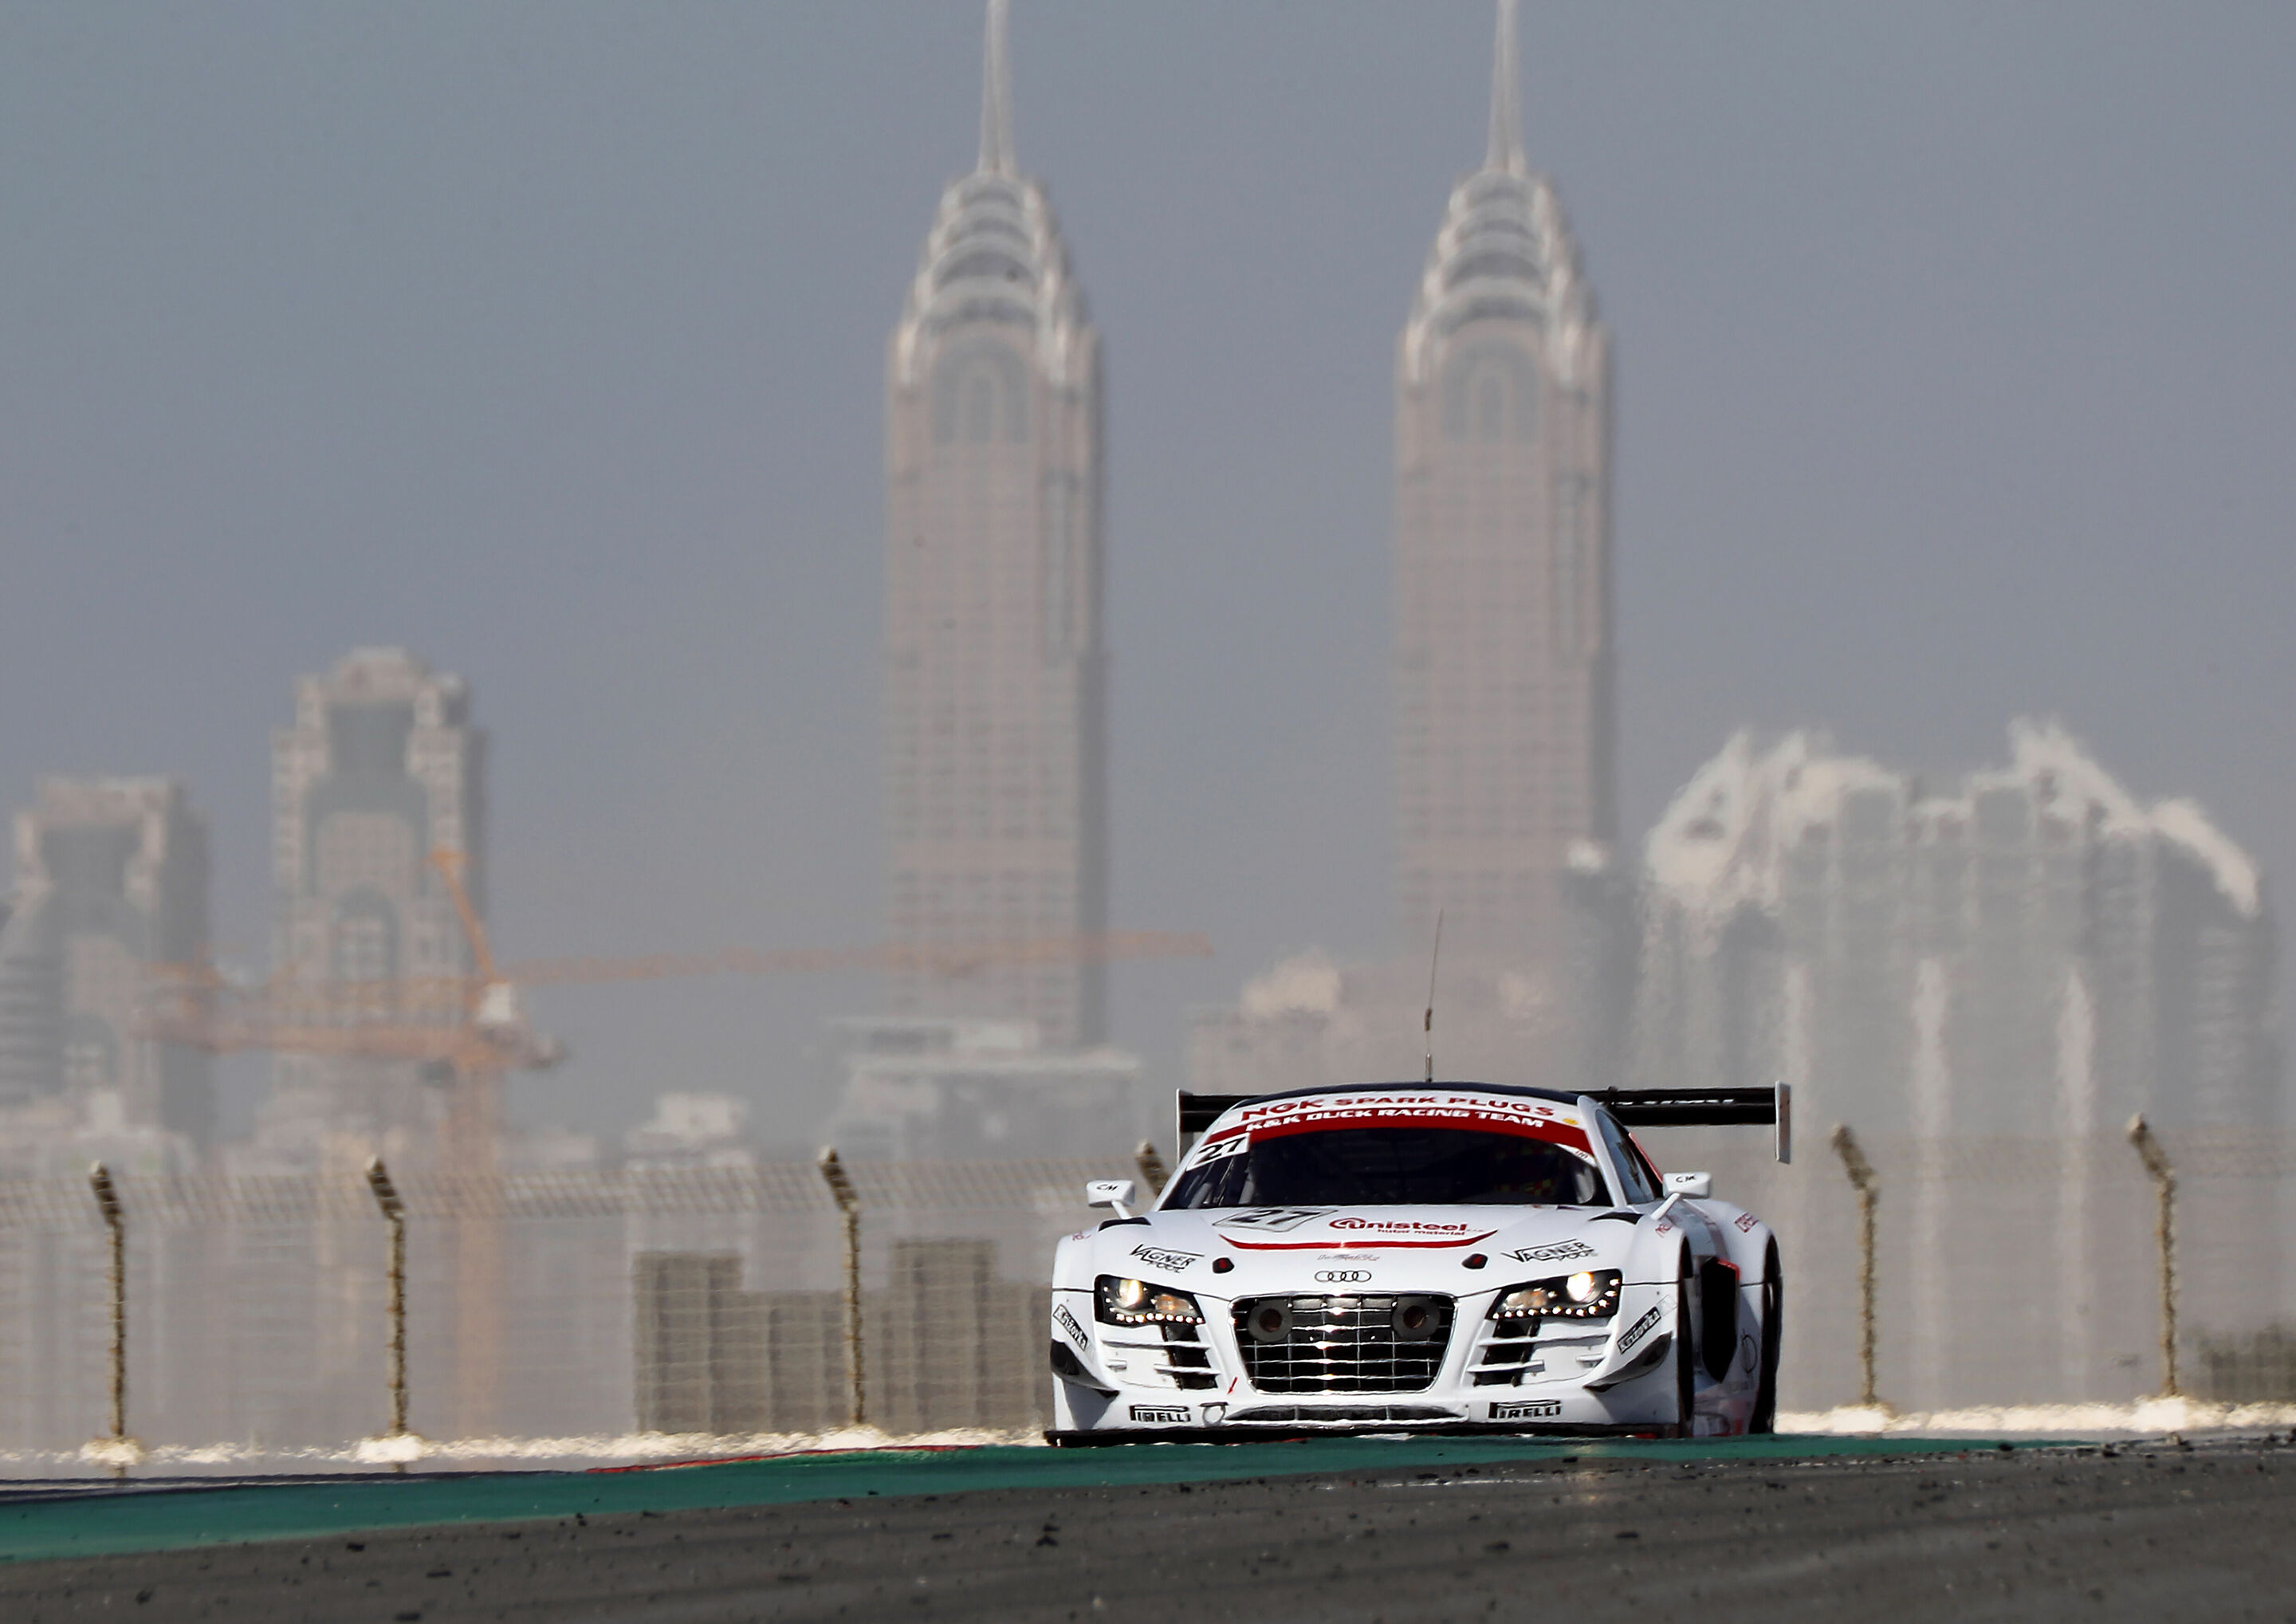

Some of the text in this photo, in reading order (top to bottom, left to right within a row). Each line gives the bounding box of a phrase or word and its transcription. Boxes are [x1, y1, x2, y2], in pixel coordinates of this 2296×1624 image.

[1241, 1097, 1555, 1122] NGK SPARK PLUGS
[1245, 1107, 1545, 1131] K&K DUCK RACING TEAM
[1196, 1136, 1247, 1165] 27
[1229, 1209, 1322, 1225] 27
[1130, 1405, 1191, 1422] PIRELLI
[1488, 1399, 1561, 1418] PIRELLI
